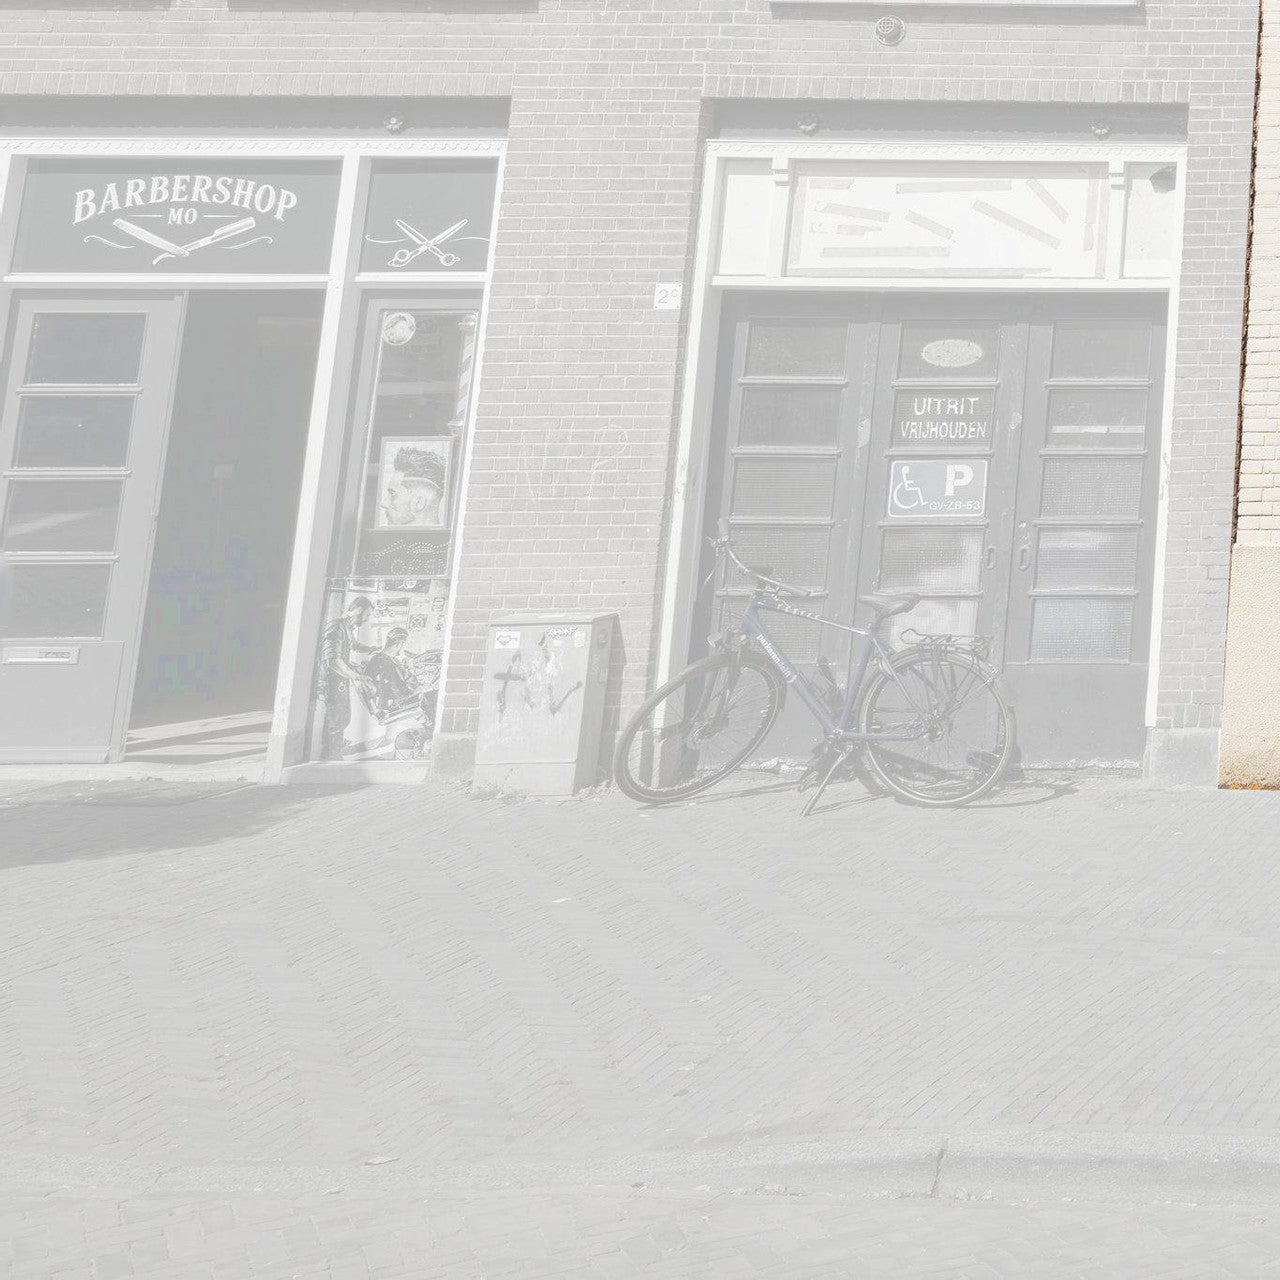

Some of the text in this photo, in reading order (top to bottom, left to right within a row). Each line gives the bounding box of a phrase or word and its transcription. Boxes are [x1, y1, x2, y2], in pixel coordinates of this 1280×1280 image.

[72, 175, 298, 226] BARBERSHOP
[167, 208, 198, 225] MO
[914, 397, 979, 415] UITRIT
[900, 420, 986, 439] VRIJHOUDEN
[945, 464, 974, 496] P
